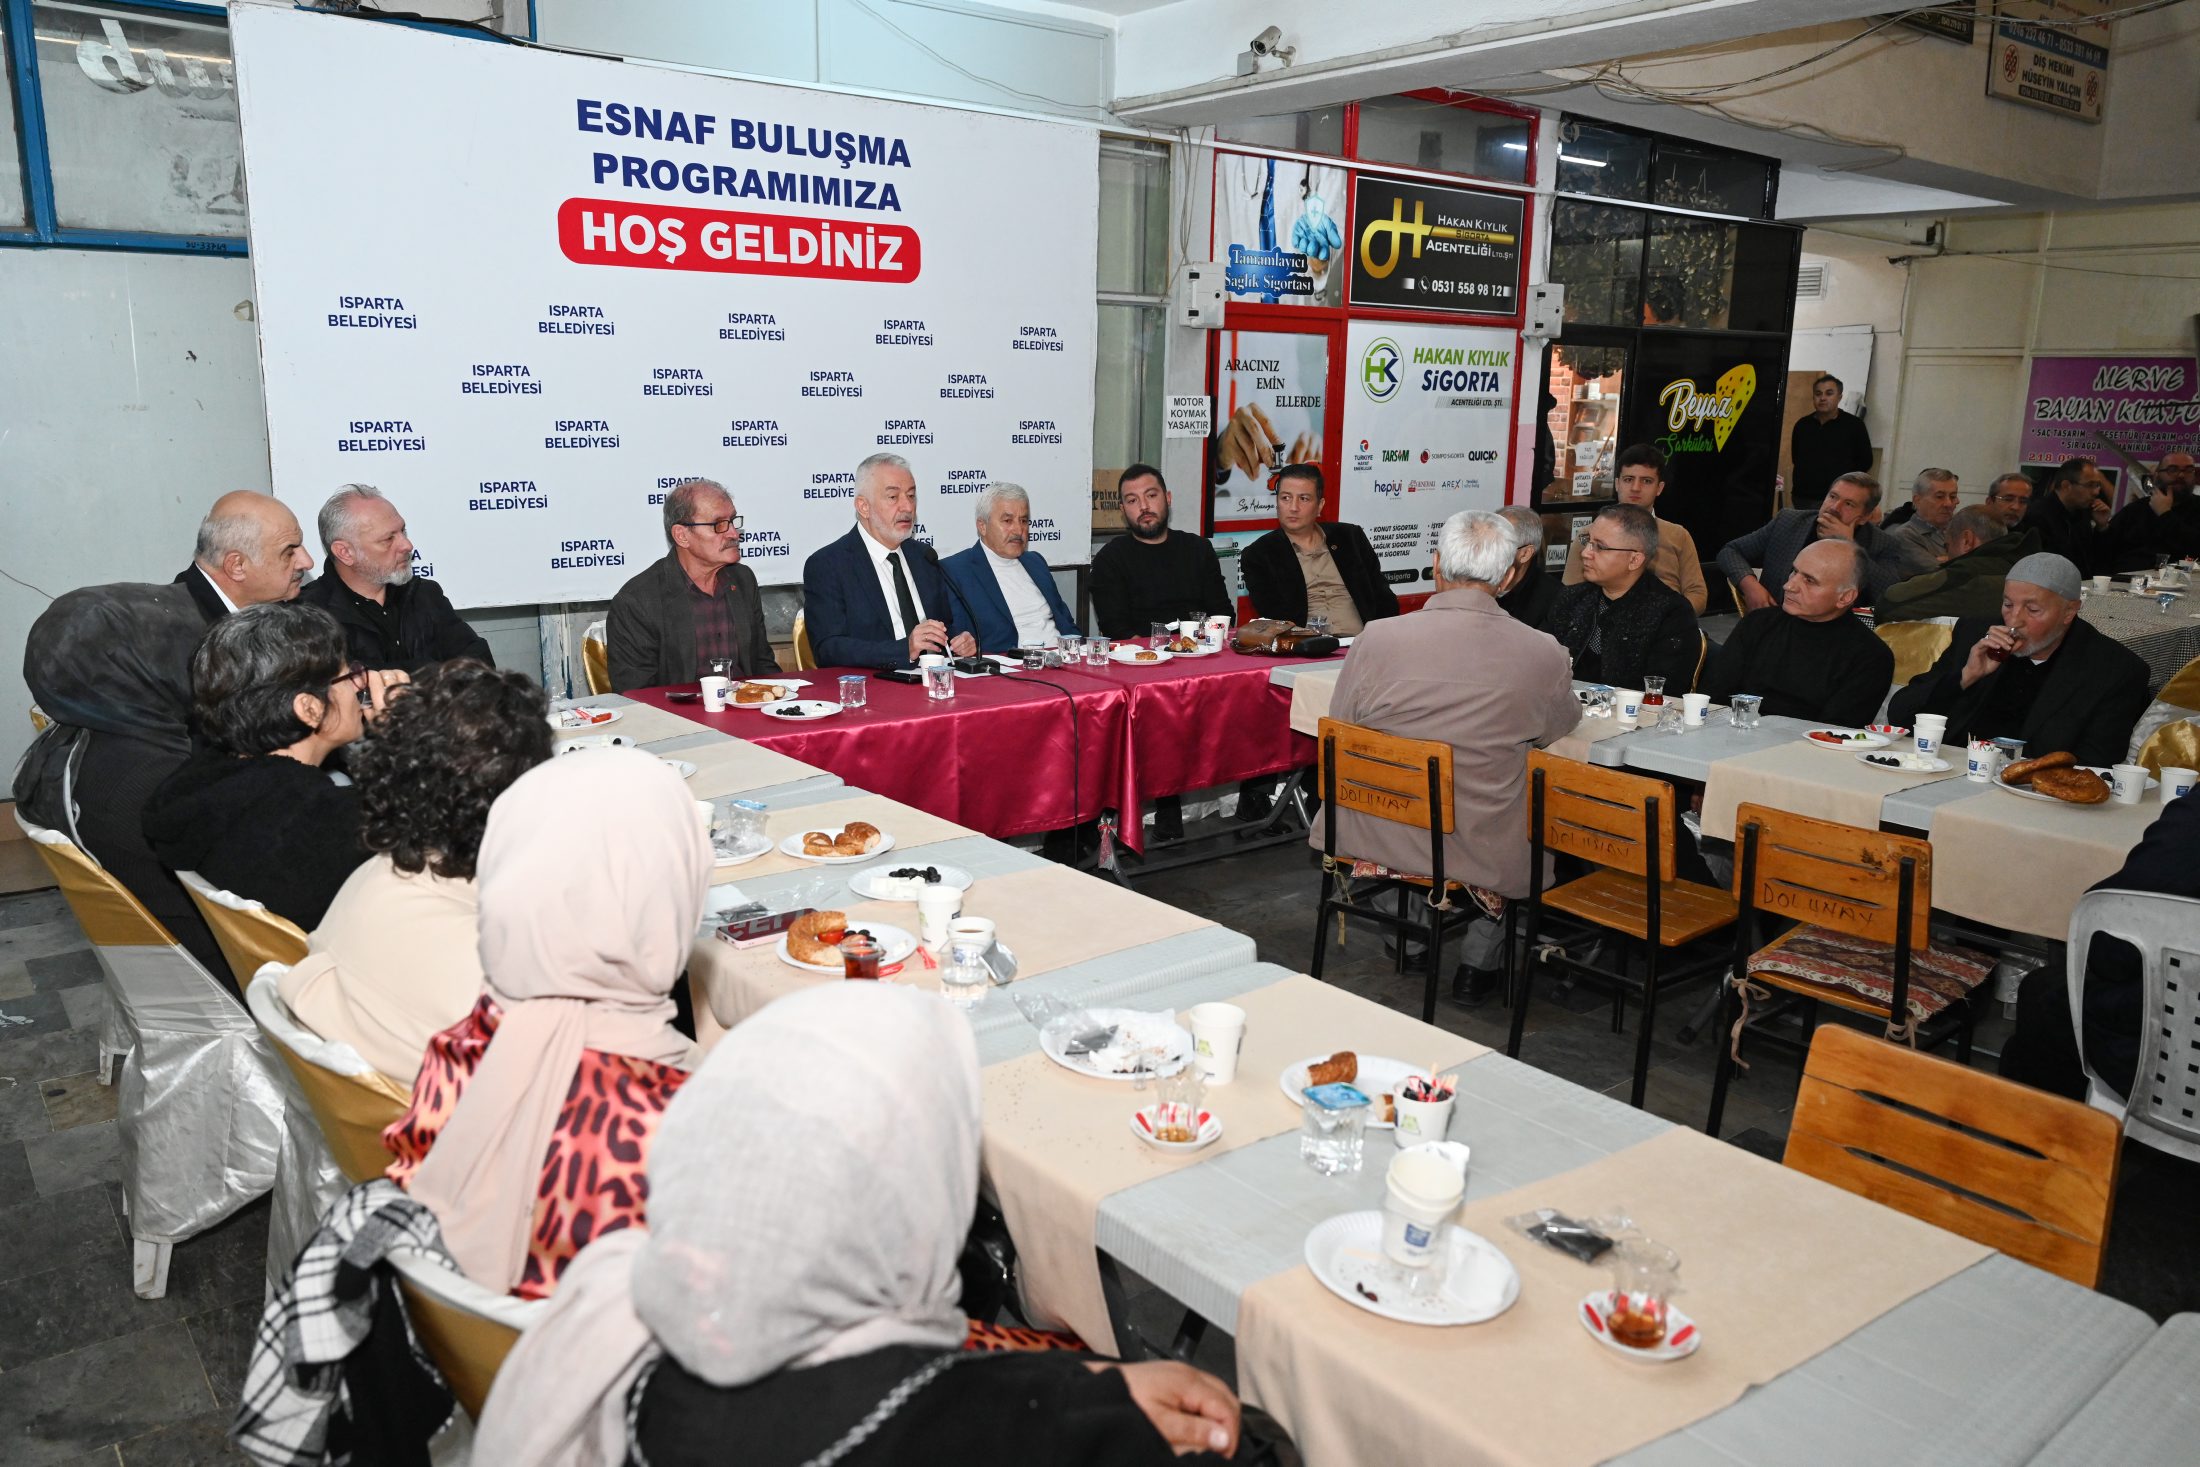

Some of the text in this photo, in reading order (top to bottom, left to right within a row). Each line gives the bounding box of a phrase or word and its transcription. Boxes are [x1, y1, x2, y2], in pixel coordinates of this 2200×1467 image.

[2026, 27, 2037, 42] 232
[2033, 54, 2075, 77] DİŞ HEKİMİ
[2022, 69, 2054, 89] HÜSEYİN
[2057, 79, 2081, 99] YALÇIN
[577, 98, 911, 169] ESNAF BULUŞMA
[593, 152, 902, 212] PROGRAMIMIZA
[1438, 214, 1508, 232] HAKAN KIYLIK
[582, 211, 903, 271] HOŞ GELDİNİZ
[1426, 239, 1492, 256] ACENTELİĞİ
[1232, 249, 1304, 270] Tamamlayıcı
[1263, 274, 1311, 291] Sigortası
[1432, 280, 1502, 297] 0531 558 98 12
[339, 296, 404, 311] ISPARTA
[548, 305, 604, 318] ISPARTA
[328, 314, 417, 329] BELEDİYESİ
[728, 313, 776, 325] ISPARTA
[883, 320, 926, 331] ISPARTA
[538, 321, 615, 336] BELEDİYESİ
[719, 328, 785, 341] BELEDİYESİ
[1020, 326, 1058, 337] ISPARTA
[875, 332, 933, 346] BELEDİYESİ
[1012, 338, 1064, 352] BELEDİYESİ
[1413, 347, 1510, 367] HAKAN KIYLIK
[472, 365, 531, 377] ISPARTA
[1225, 359, 1280, 372] ARACINIZ
[653, 369, 703, 380] ISPARTA
[810, 371, 854, 382] ISPARTA
[948, 374, 987, 385] ISPARTA
[2093, 366, 2184, 391] MERVE
[462, 380, 542, 394] BELEDİYESİ
[1256, 376, 1285, 389] EMİN
[644, 383, 713, 396] BELEDİYESİ
[801, 383, 862, 397] BELEDİYESİ
[940, 386, 994, 399] BELEDİYESİ
[1174, 398, 1203, 406] MOTOR
[1276, 396, 1321, 407] ELLERDE
[1659, 378, 1733, 432] Beyaz
[1170, 409, 1206, 417] KOYMAK
[2033, 397, 2114, 423] BAYAN
[350, 421, 412, 433] ISPARTA
[555, 421, 609, 432] ISPARTA
[731, 421, 778, 431] ISPARTA
[885, 420, 926, 430] ISPARTA
[1019, 421, 1055, 430] ISPARTA
[1168, 421, 1208, 429] YASAKTIR
[545, 435, 620, 448] BELEDİYESİ
[723, 434, 787, 446] BELEDİYESİ
[877, 433, 933, 445] BELEDİYESİ
[1012, 433, 1062, 444] BELEDİYESİ
[2053, 429, 2086, 438] TASARIM
[2141, 431, 2177, 441] TASARIM
[338, 437, 425, 452] BELEDİYESİ
[1468, 451, 1494, 461] QUICK
[2029, 453, 2053, 461] 218
[812, 473, 855, 483] ISPARTA
[948, 470, 986, 480] ISPARTA
[480, 481, 536, 493] ISPARTA
[803, 485, 855, 498] BELEDİYE
[940, 482, 995, 494] BELEDİYE
[469, 496, 548, 511] BELEDİYESİ
[1027, 519, 1054, 528] PARTA
[739, 532, 780, 542] SPARTA
[1027, 530, 1061, 541] EDİYESİ
[561, 539, 614, 552] ISPARTA
[739, 544, 789, 557] LEDİYESİ
[551, 552, 625, 569] BELEDİYESİ
